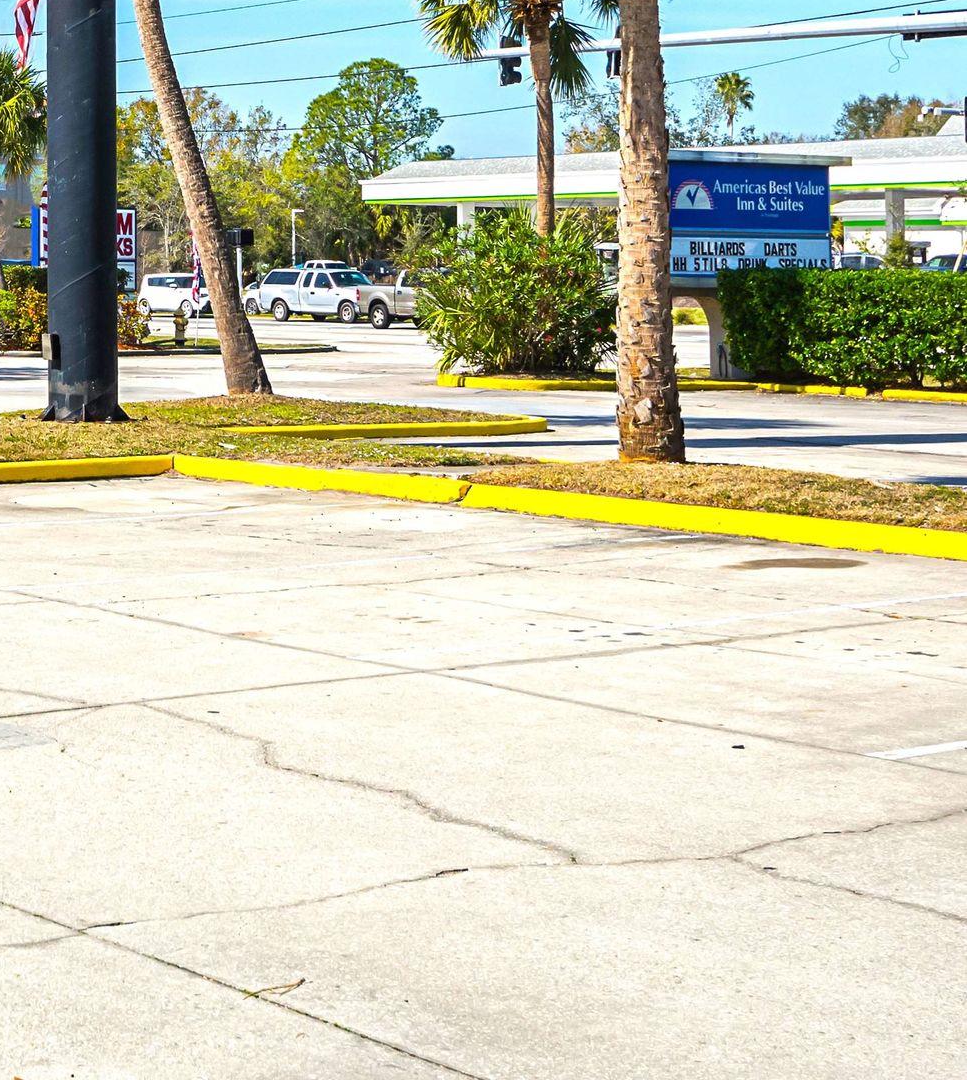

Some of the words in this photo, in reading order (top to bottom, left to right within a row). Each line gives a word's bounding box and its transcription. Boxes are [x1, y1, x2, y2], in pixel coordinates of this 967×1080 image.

[712, 179, 767, 195] Americas
[769, 180, 792, 195] Best
[794, 180, 825, 196] Value
[736, 196, 755, 211] Inn
[757, 196, 767, 211] &
[770, 196, 804, 212] Suites
[689, 241, 745, 256] BILLIARDS
[764, 242, 797, 257] DARTS
[673, 257, 687, 271] HH
[738, 258, 767, 269] DRINK
[779, 258, 827, 270] SPECIALS
